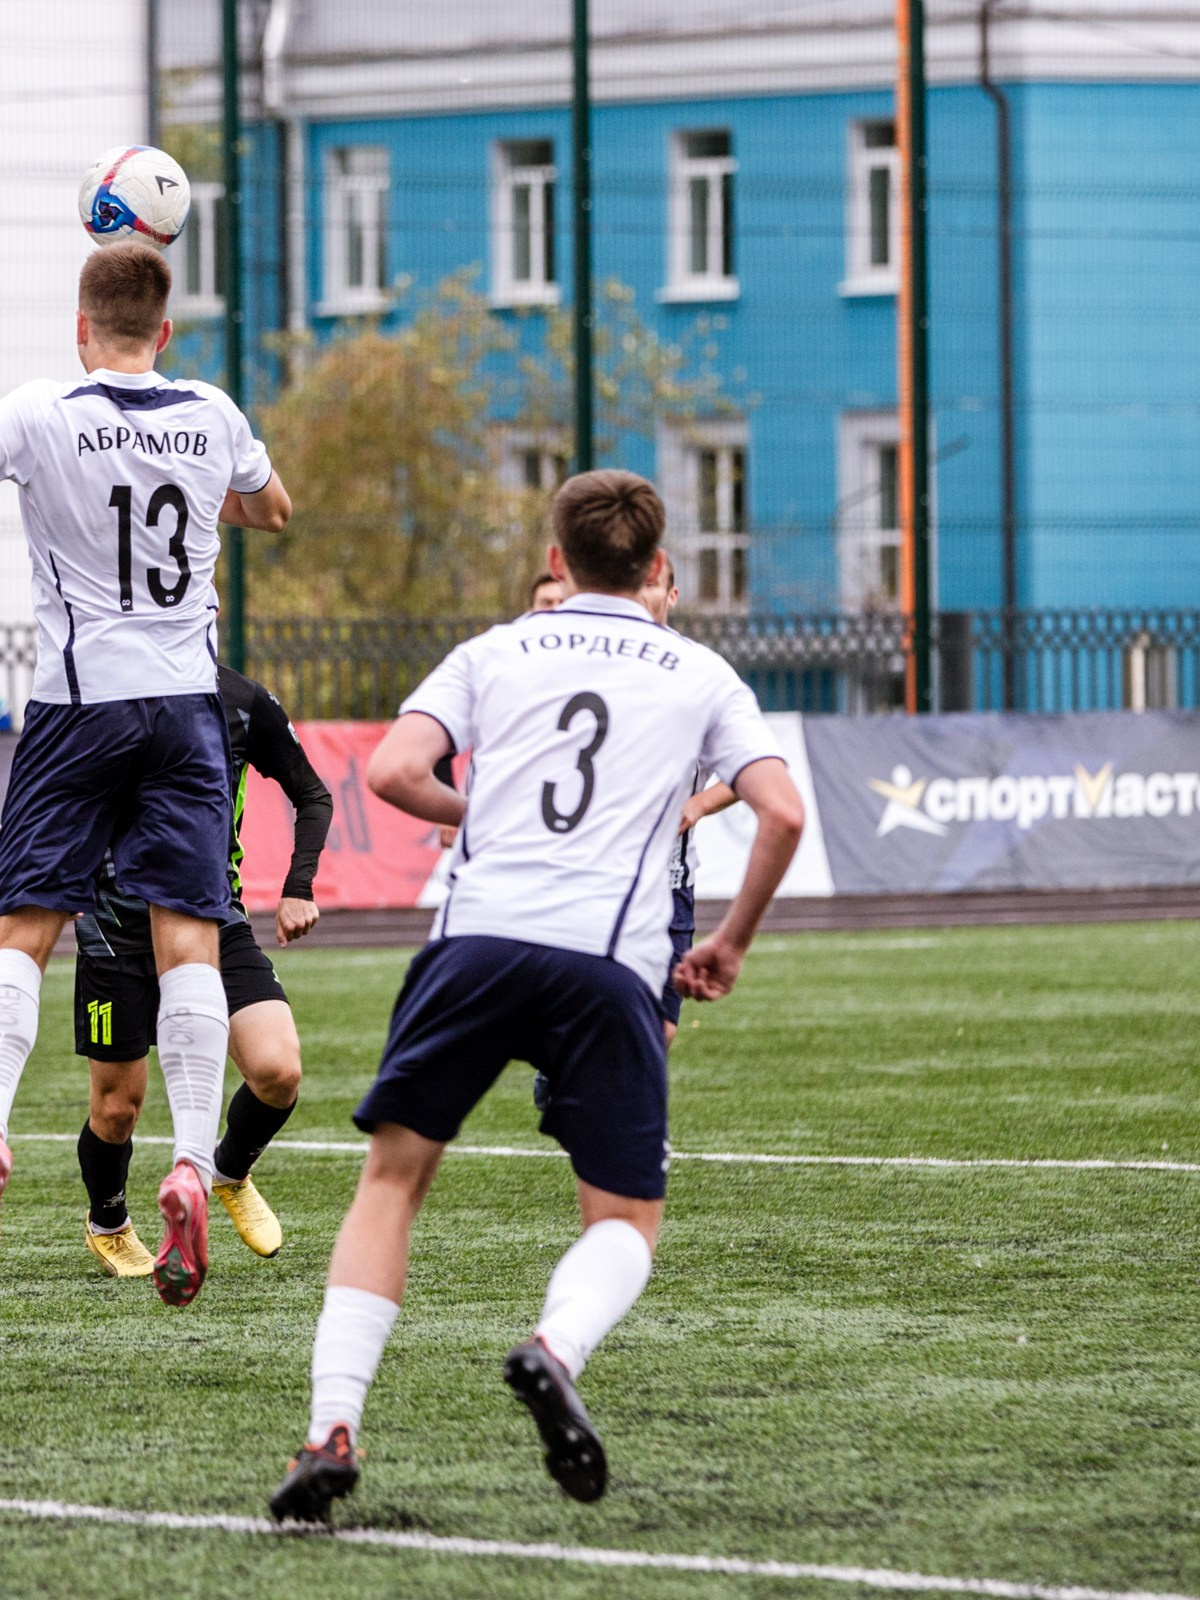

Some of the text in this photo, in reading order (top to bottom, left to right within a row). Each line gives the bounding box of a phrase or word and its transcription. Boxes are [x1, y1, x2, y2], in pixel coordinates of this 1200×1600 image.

[78, 426, 208, 457] АБРАМОВ
[108, 484, 191, 612] 13
[520, 633, 680, 671] ГОРДЕЕВ
[541, 691, 609, 834] 3
[924, 761, 1200, 830] спортМаст
[88, 1000, 112, 1046] 11
